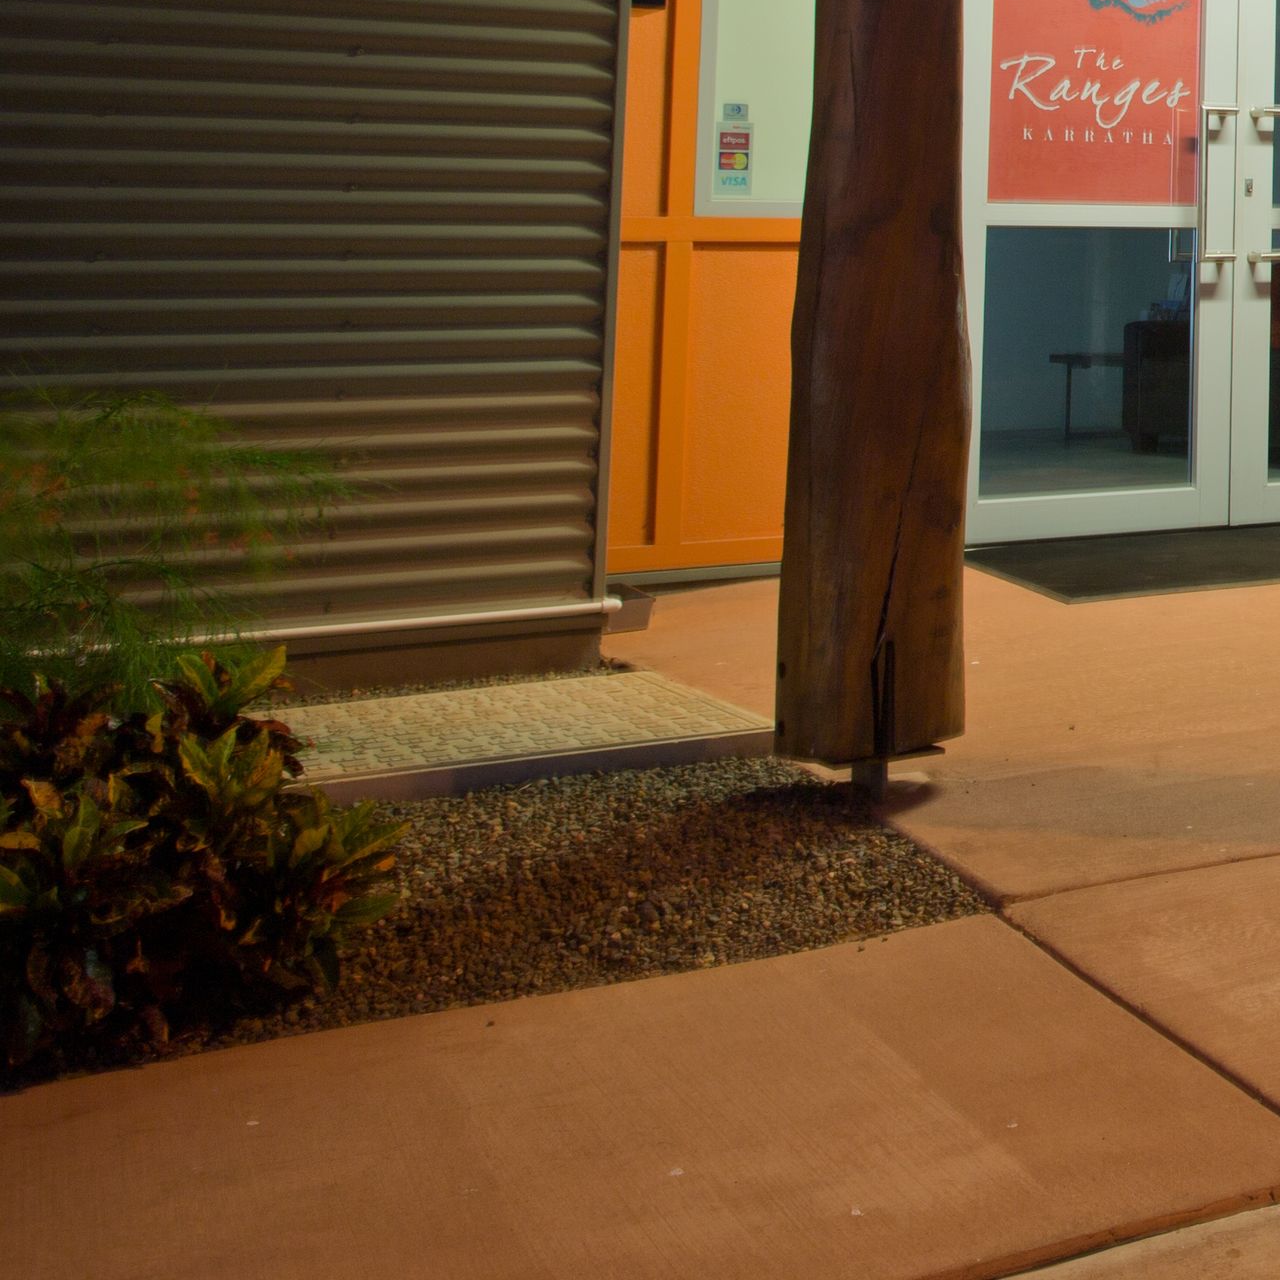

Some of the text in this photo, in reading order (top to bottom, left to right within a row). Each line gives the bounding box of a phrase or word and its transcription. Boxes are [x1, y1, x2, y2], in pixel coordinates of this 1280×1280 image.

[1073, 49, 1124, 70] The
[1000, 55, 1191, 129] Ranges
[1023, 127, 1172, 145] KARRATHA
[720, 176, 747, 186] VISA
